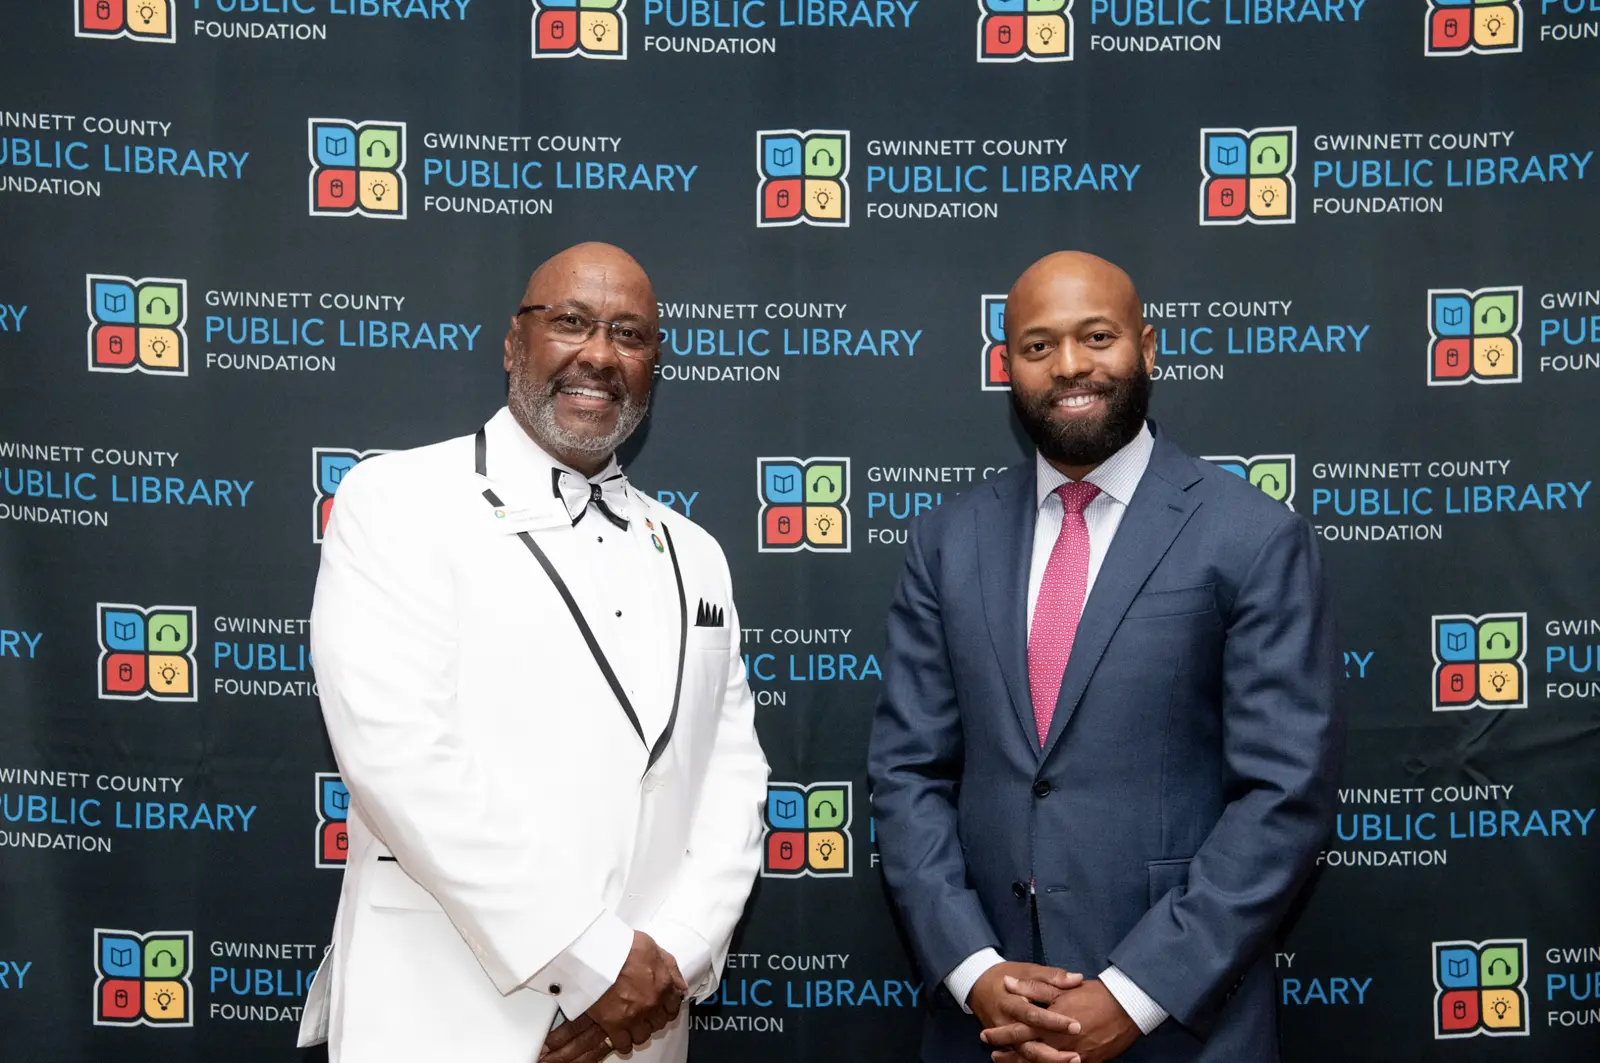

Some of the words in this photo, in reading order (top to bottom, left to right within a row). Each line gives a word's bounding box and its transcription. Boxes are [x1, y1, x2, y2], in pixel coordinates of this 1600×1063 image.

[644, 0, 766, 29] PUBLIC
[779, 0, 919, 28] LIBRARY
[1090, 0, 1211, 27] PUBLIC
[1225, 0, 1366, 25] LIBRARY
[194, 19, 327, 40] FOUNDATION
[644, 35, 776, 54] FOUNDATION
[1090, 34, 1221, 52] FOUNDATION
[0, 110, 76, 131] INNETT
[82, 116, 172, 137] COUNTY
[423, 132, 532, 152] GWINNETT
[537, 135, 622, 153] COUNTY
[866, 139, 976, 156] GWINNETT
[982, 138, 1068, 156] COUNTY
[1313, 131, 1423, 151] GWINNETT
[1428, 129, 1515, 149] COUNTY
[103, 143, 250, 180] LIBRARY
[1312, 158, 1434, 189] PUBLIC
[1447, 151, 1594, 187] LIBRARY
[423, 158, 543, 190] PUBLIC
[556, 161, 698, 193] LIBRARY
[867, 164, 988, 194] PUBLIC
[1002, 162, 1141, 193] LIBRARY
[424, 195, 553, 215] FOUNDATION
[867, 202, 998, 219] FOUNDATION
[1312, 196, 1443, 214] FOUNDATION
[205, 290, 313, 309] GWINNETT
[319, 292, 406, 312] COUNTY
[764, 302, 848, 319] COUNTY
[1207, 300, 1293, 318] COUNTY
[1540, 289, 1600, 310] GWIN
[205, 315, 325, 347] PUBLIC
[339, 319, 482, 352] LIBRARY
[783, 327, 923, 357] LIBRARY
[1227, 324, 1371, 355] LIBRARY
[206, 352, 336, 372] FOUNDATION
[1151, 364, 1224, 381] DATION
[0, 441, 85, 463] WINNETT
[91, 448, 179, 468] COUNTY
[867, 466, 976, 483] GWINNETT
[1312, 462, 1422, 479] GWINNETT
[1427, 459, 1511, 478] COUNTY
[0, 466, 97, 501] UBLIC
[111, 474, 254, 508] LIBRARY
[1312, 487, 1433, 516] PUBLIC
[1446, 480, 1592, 514] LIBRARY
[0, 503, 108, 527] OUNDATION
[770, 628, 852, 645] COUNTY
[1545, 618, 1600, 637] GWIN
[213, 641, 313, 671] PUBLI
[788, 653, 883, 681] LIBRA
[213, 678, 319, 697] FOUNDATI
[0, 767, 90, 789] WINNETT
[96, 774, 184, 793] COUNTY
[1430, 784, 1514, 803] COUNTY
[0, 793, 101, 827] UBLIC
[115, 801, 257, 832] LIBRARY
[1336, 812, 1437, 841] UBLIC
[1449, 808, 1596, 839] LIBRARY
[0, 830, 112, 853] OUNDATION
[210, 940, 317, 959] GWINNETT
[1546, 947, 1600, 964] GWIN
[767, 953, 850, 971] COUNTY
[786, 979, 924, 1008] LIBRARY
[1282, 977, 1372, 1005] RARY
[209, 1002, 303, 1022] FOUNDAT
